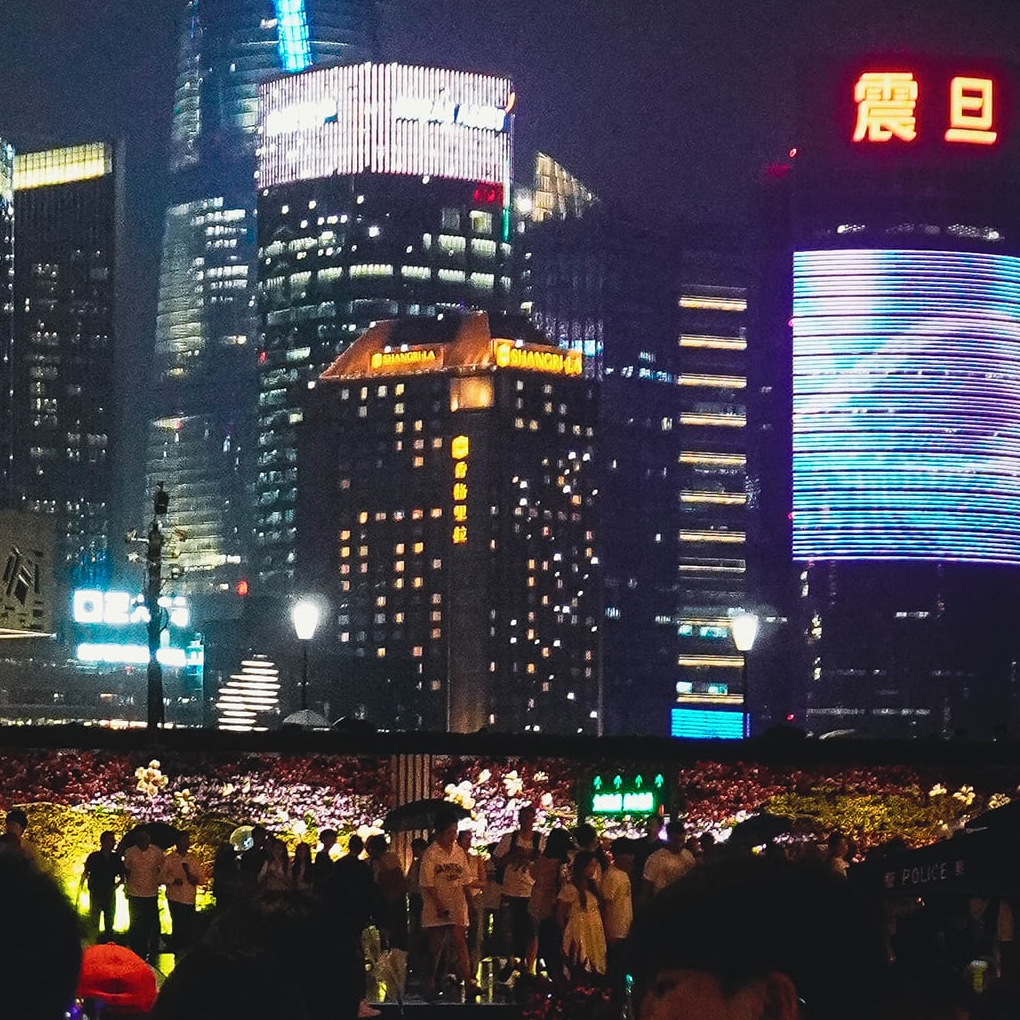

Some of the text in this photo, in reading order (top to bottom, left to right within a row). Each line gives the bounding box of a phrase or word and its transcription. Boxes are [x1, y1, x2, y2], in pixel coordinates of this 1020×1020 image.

[853, 72, 998, 145] 震旦
[382, 349, 437, 366] SHANGRI-LA
[510, 347, 583, 376] SHANGRI-LA
[902, 862, 947, 885] POLICE
